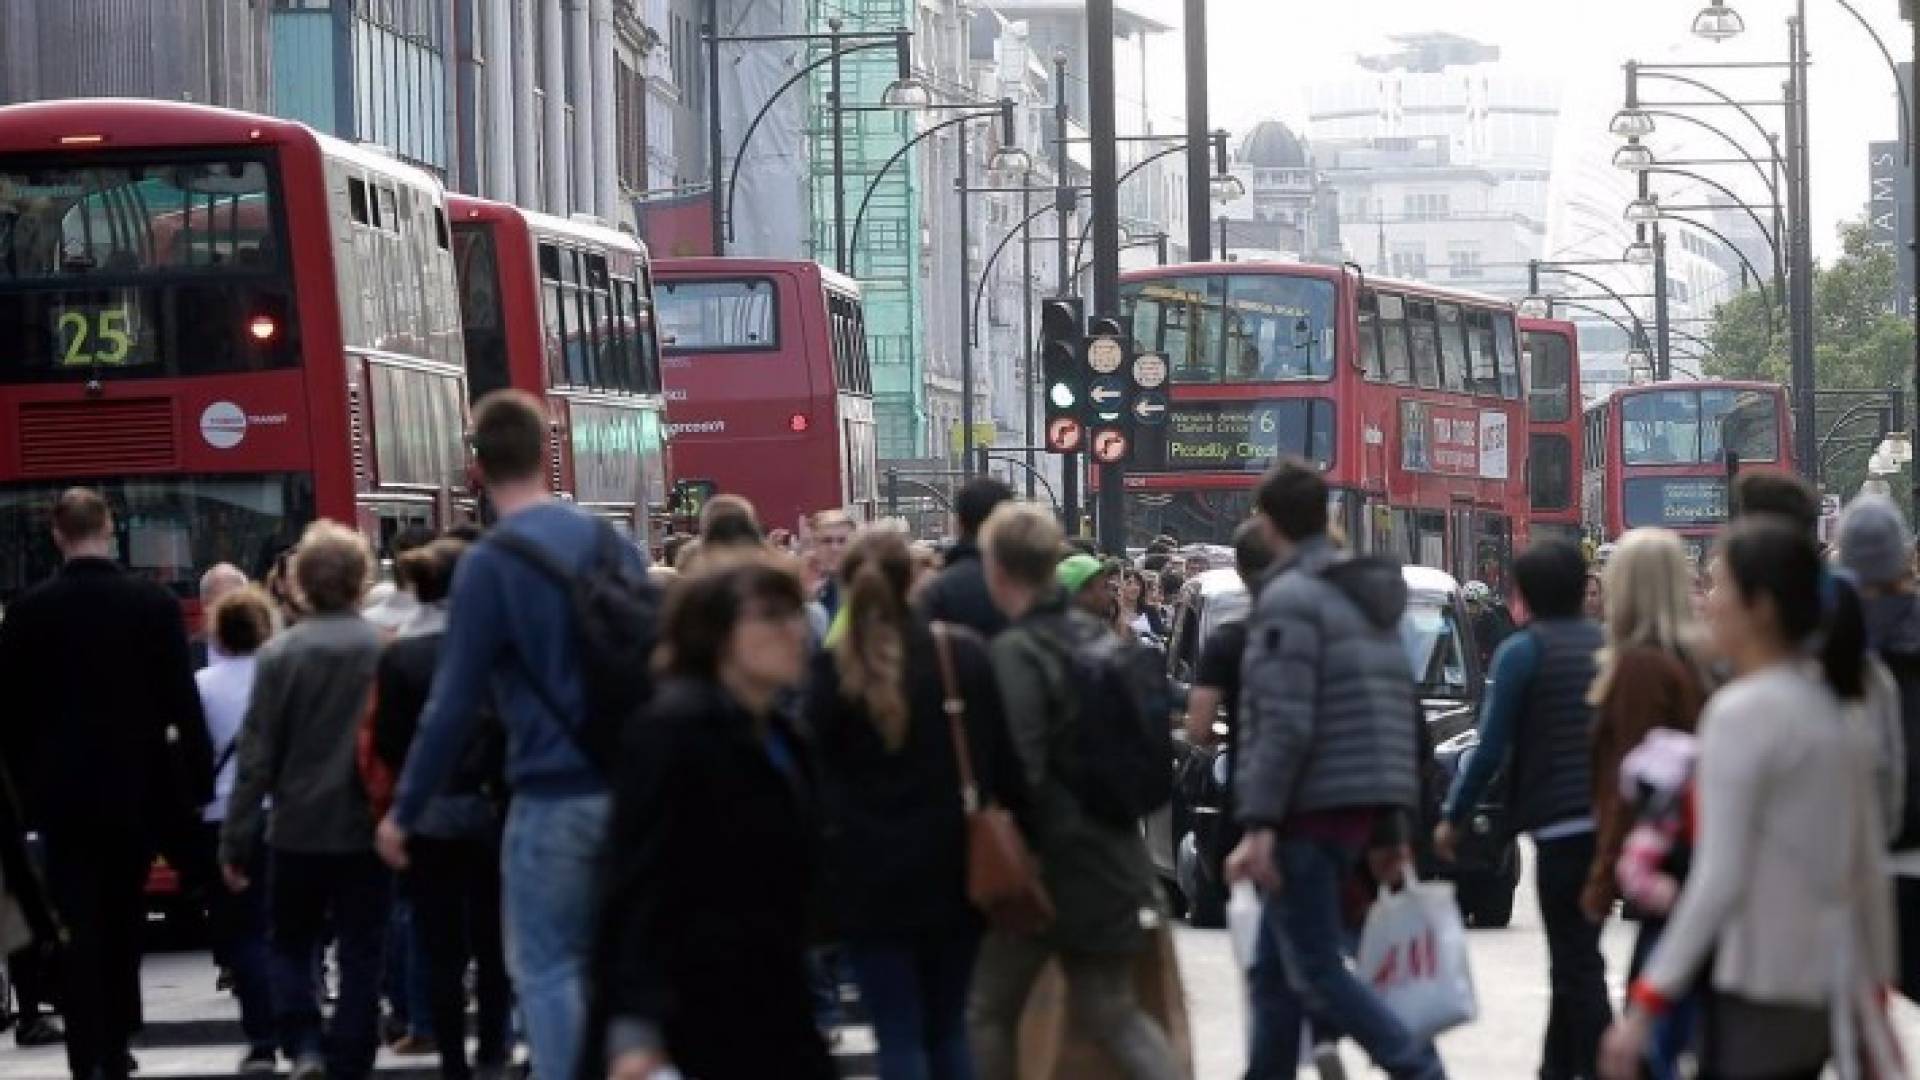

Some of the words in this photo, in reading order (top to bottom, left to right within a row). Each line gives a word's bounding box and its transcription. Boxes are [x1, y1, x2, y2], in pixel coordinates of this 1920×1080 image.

[58, 309, 130, 366] 25
[1260, 410, 1276, 433] 6
[1171, 442, 1229, 460] Piccadilly
